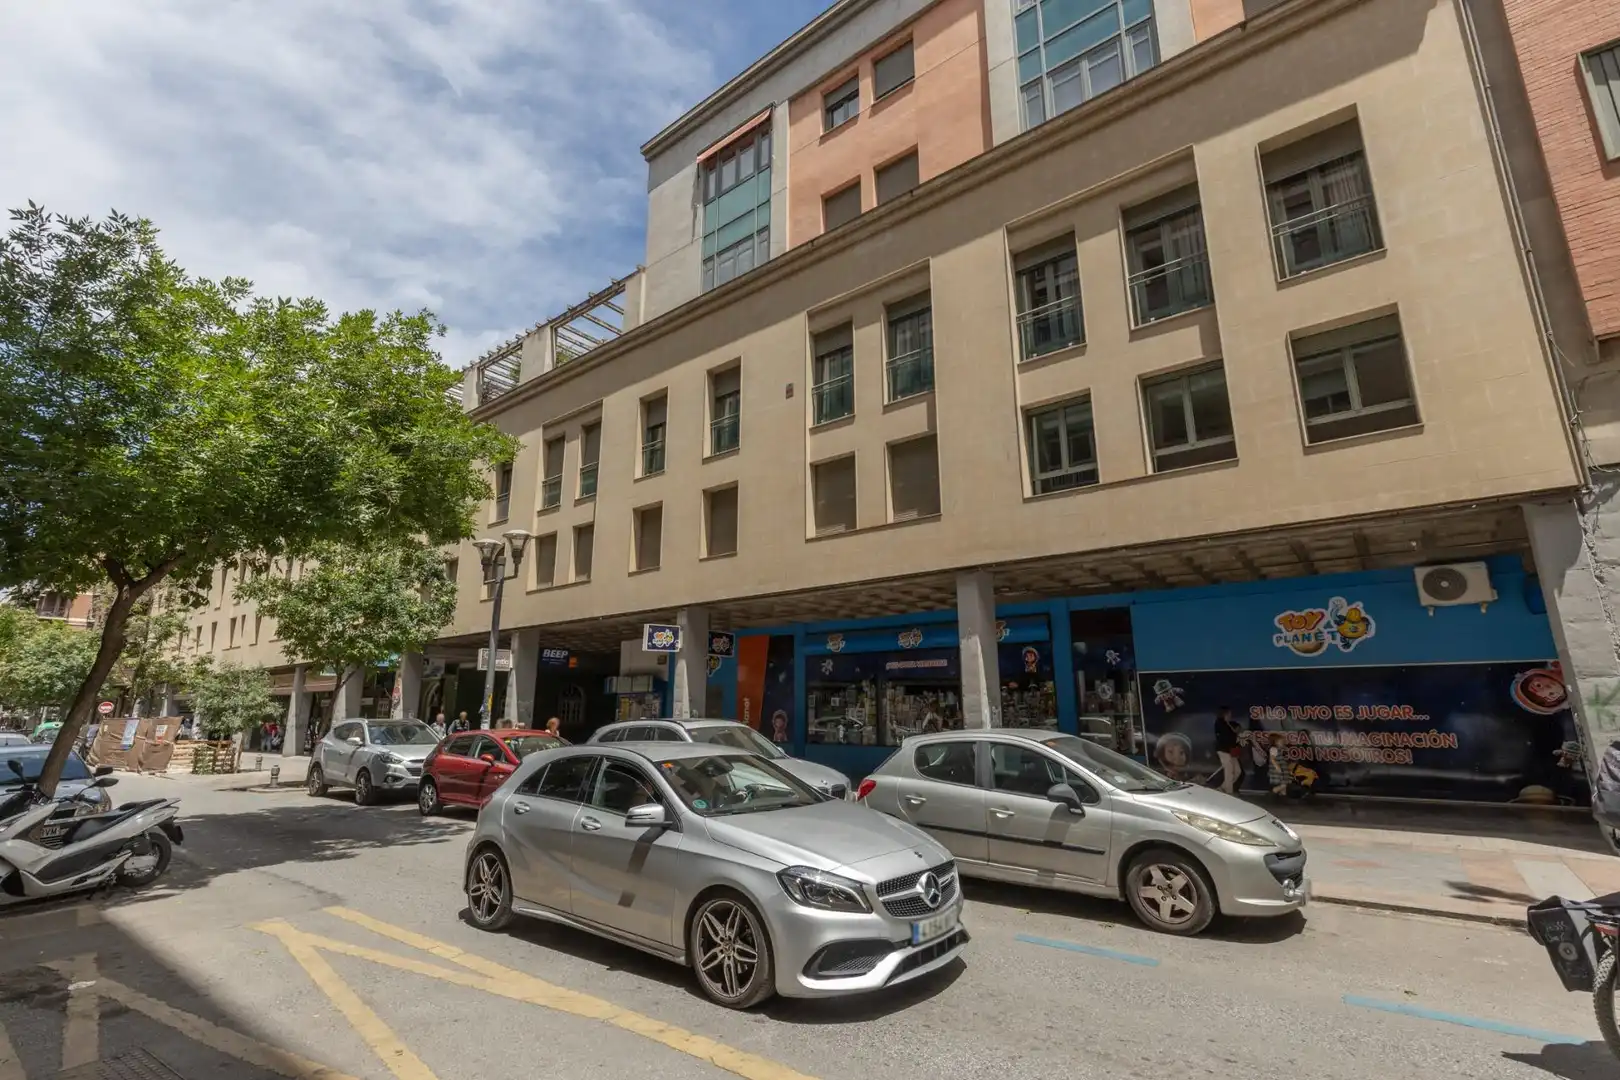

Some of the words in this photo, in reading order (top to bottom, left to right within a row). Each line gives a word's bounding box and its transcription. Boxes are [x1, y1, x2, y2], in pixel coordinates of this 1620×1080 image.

[1277, 610, 1326, 632] TOY
[1275, 630, 1338, 645] PLANET
[542, 648, 569, 659] BEEP
[1250, 706, 1265, 720] SI
[1266, 705, 1287, 720] LO
[1288, 705, 1332, 720] TUYO
[1334, 706, 1353, 720] ES
[1356, 705, 1430, 720] JUGAR...
[1312, 731, 1335, 747] TU
[1337, 729, 1459, 749] IMAGINACIÓN
[1315, 748, 1414, 765] NOSOTROS!
